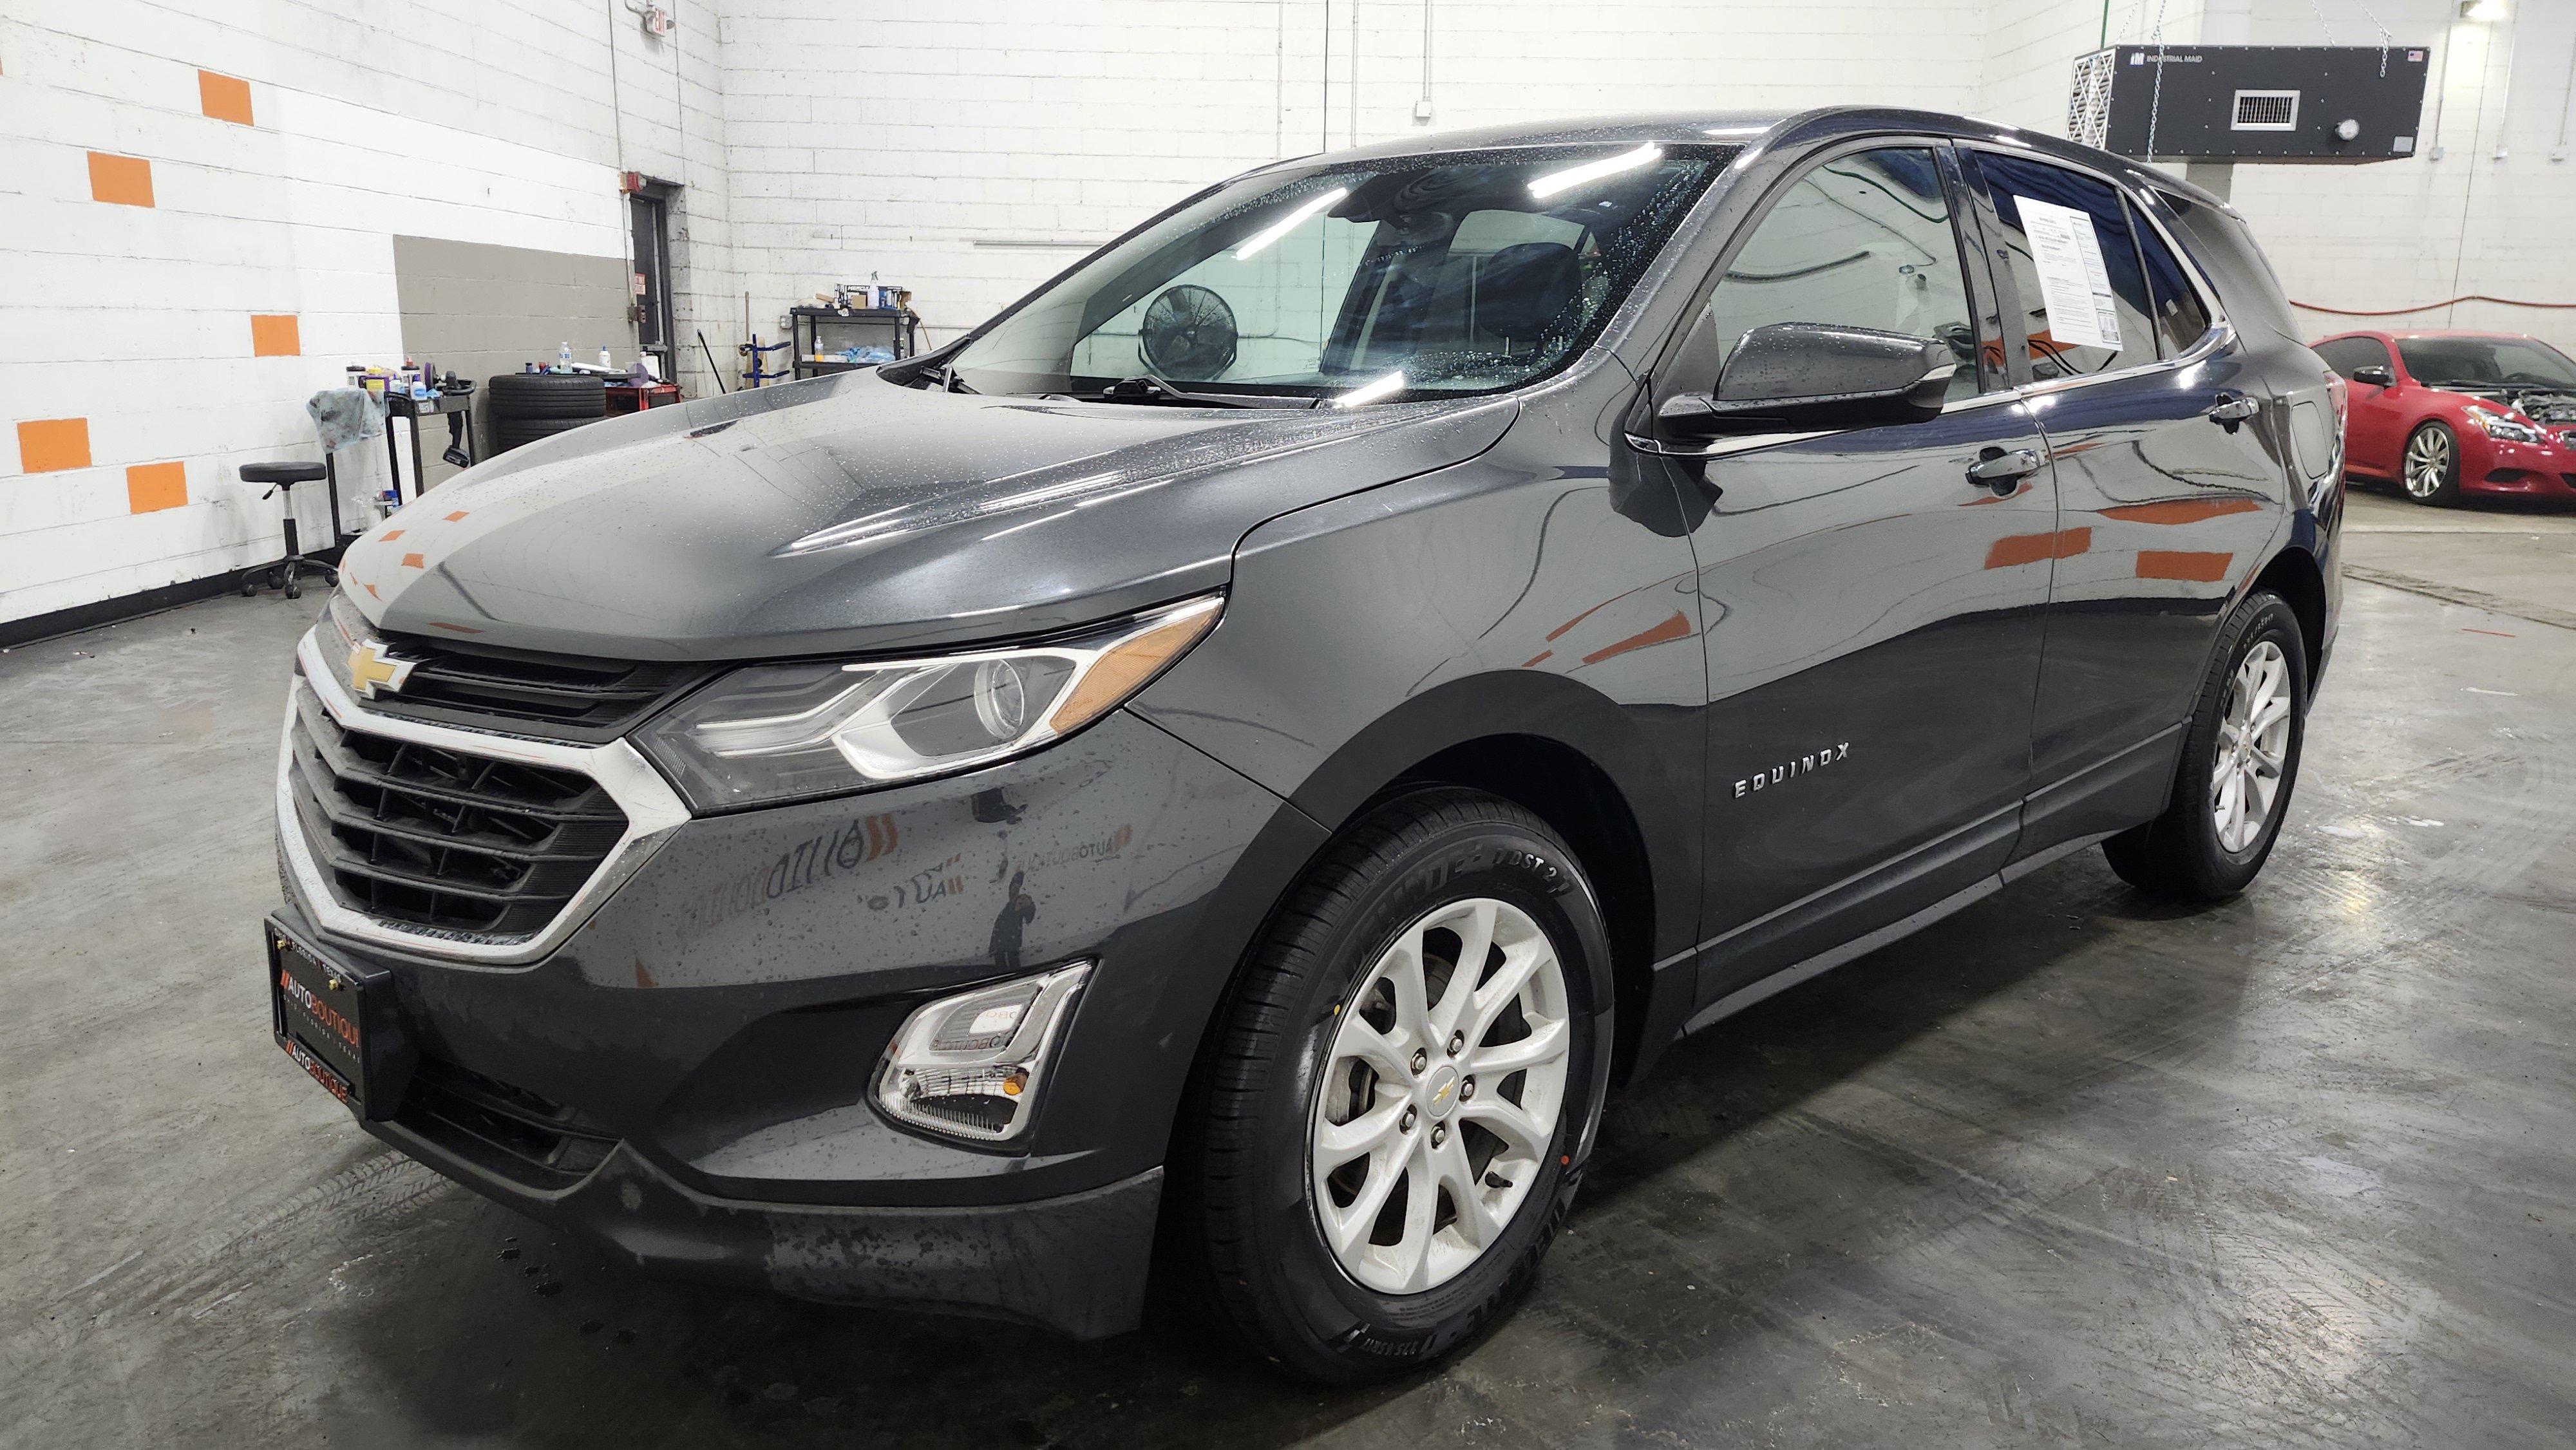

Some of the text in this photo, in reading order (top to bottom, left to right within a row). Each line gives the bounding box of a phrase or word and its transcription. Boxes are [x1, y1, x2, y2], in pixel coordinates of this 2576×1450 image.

[2184, 55, 2203, 63] MAID
[1734, 741, 1850, 799] EQUINOX
[292, 1044, 348, 1104] AUTOBOUTIQUE
